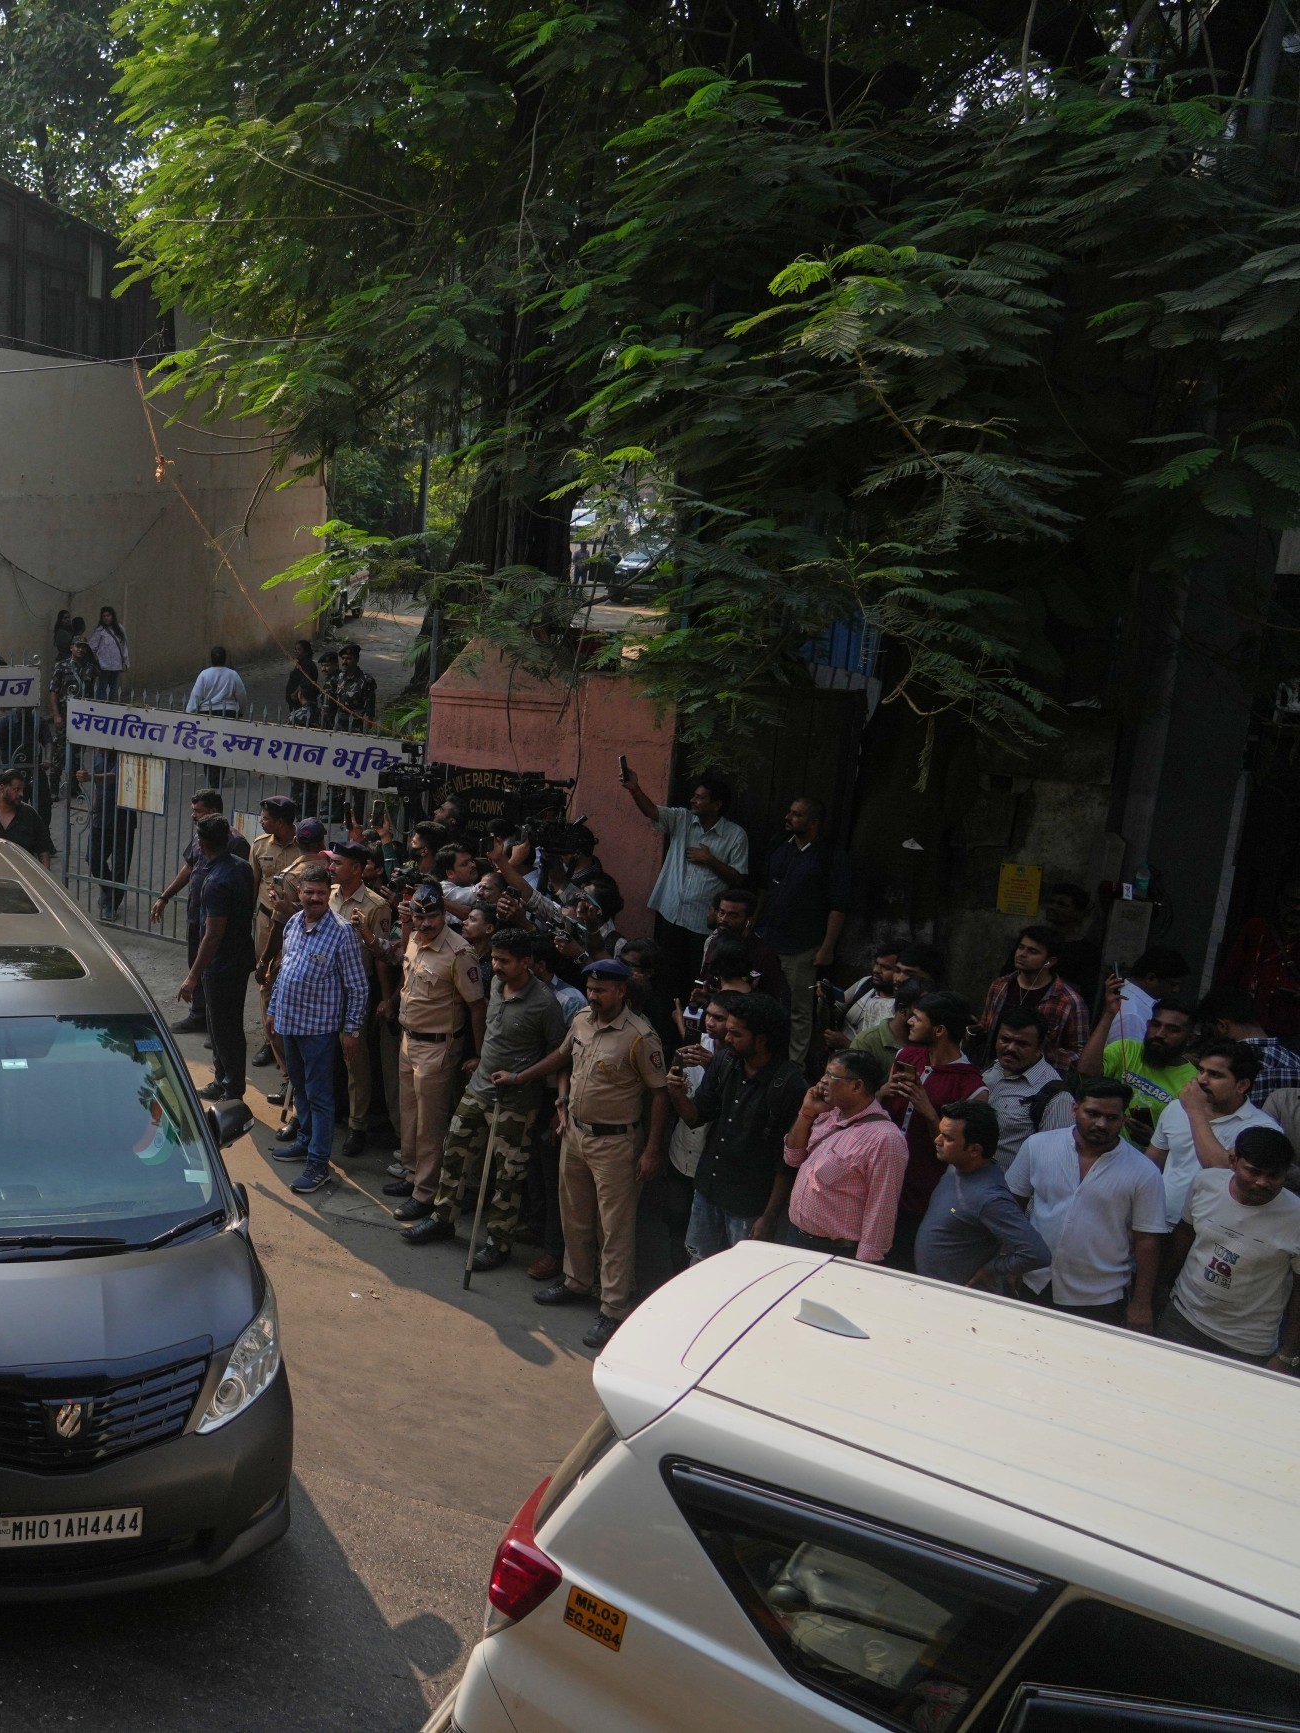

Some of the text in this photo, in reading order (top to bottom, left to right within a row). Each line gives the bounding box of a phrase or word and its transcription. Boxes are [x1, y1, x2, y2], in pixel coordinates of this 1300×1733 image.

[71, 707, 169, 742] संचालित
[173, 721, 218, 757] हिंदू
[453, 773, 472, 793] VILE
[472, 771, 502, 790] PARLE
[469, 798, 505, 816] CHOWK
[1214, 1242, 1240, 1265] UN
[1208, 1256, 1232, 1278] IQ
[11, 1512, 139, 1541] MH01AH4444
[575, 1593, 620, 1626] MH.03
[566, 1606, 621, 1648] EG.2884
